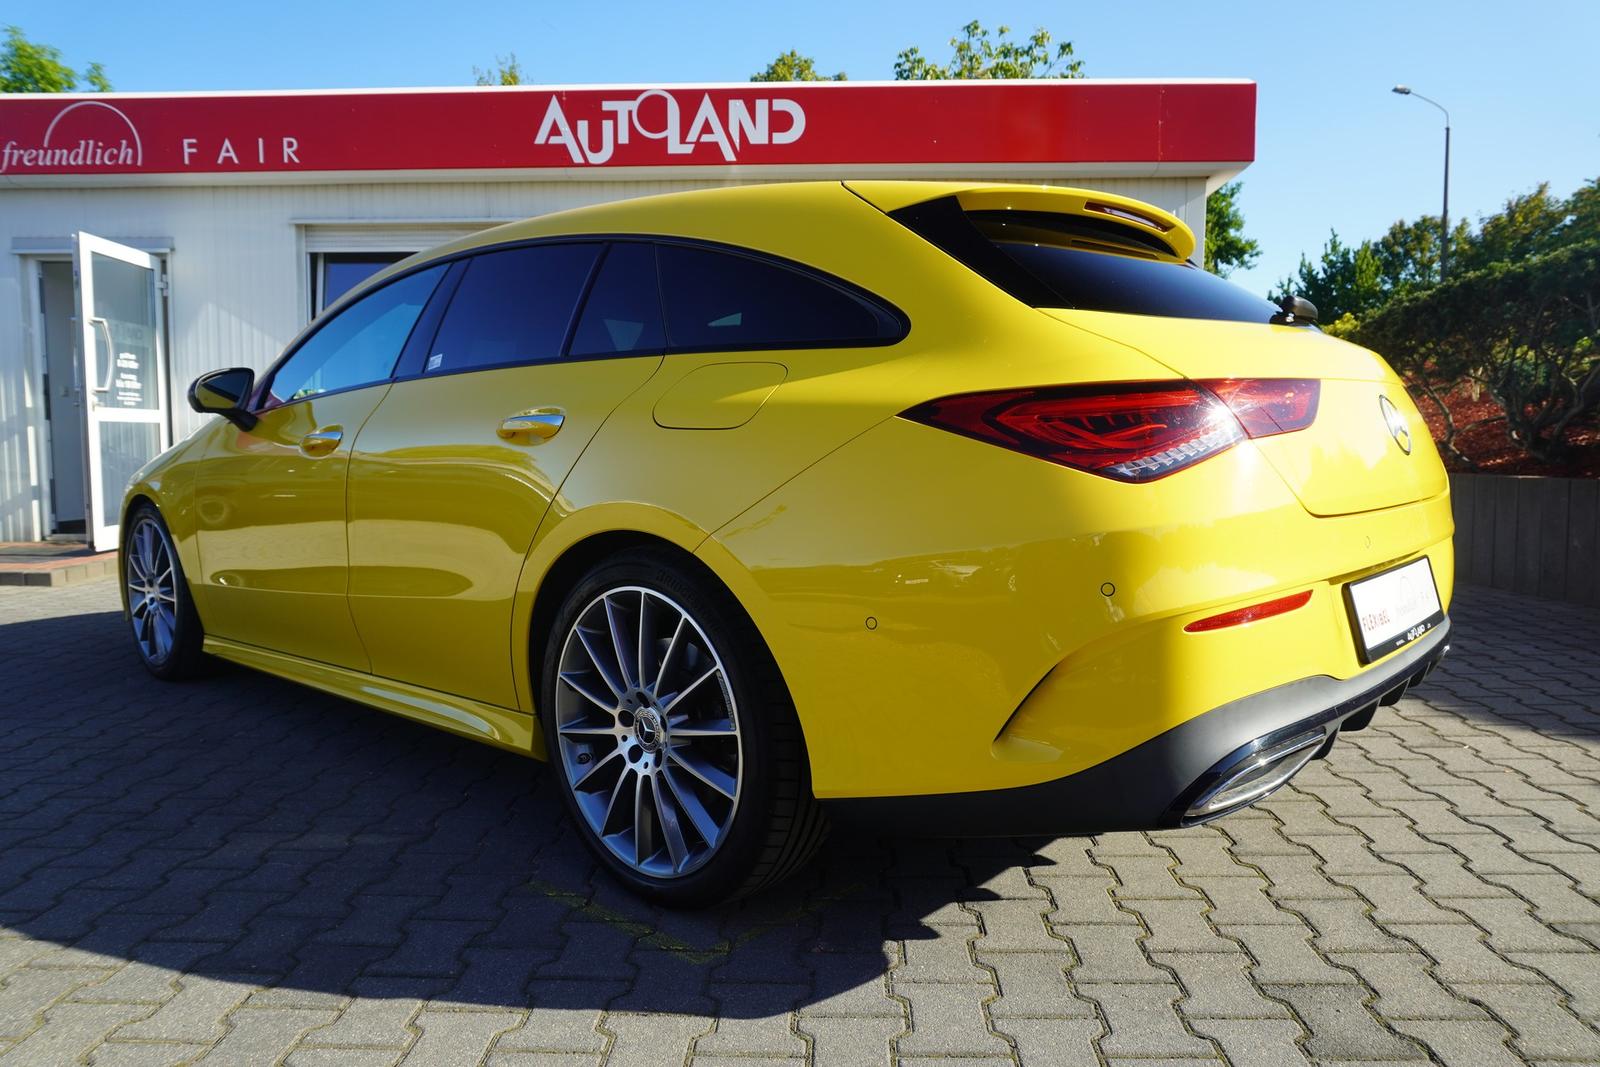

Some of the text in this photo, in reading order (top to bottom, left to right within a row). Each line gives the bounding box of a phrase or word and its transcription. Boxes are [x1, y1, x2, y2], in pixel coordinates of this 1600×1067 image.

[534, 89, 806, 164] AUTOLAND
[0, 140, 133, 172] freundlich
[182, 137, 300, 165] FAIR
